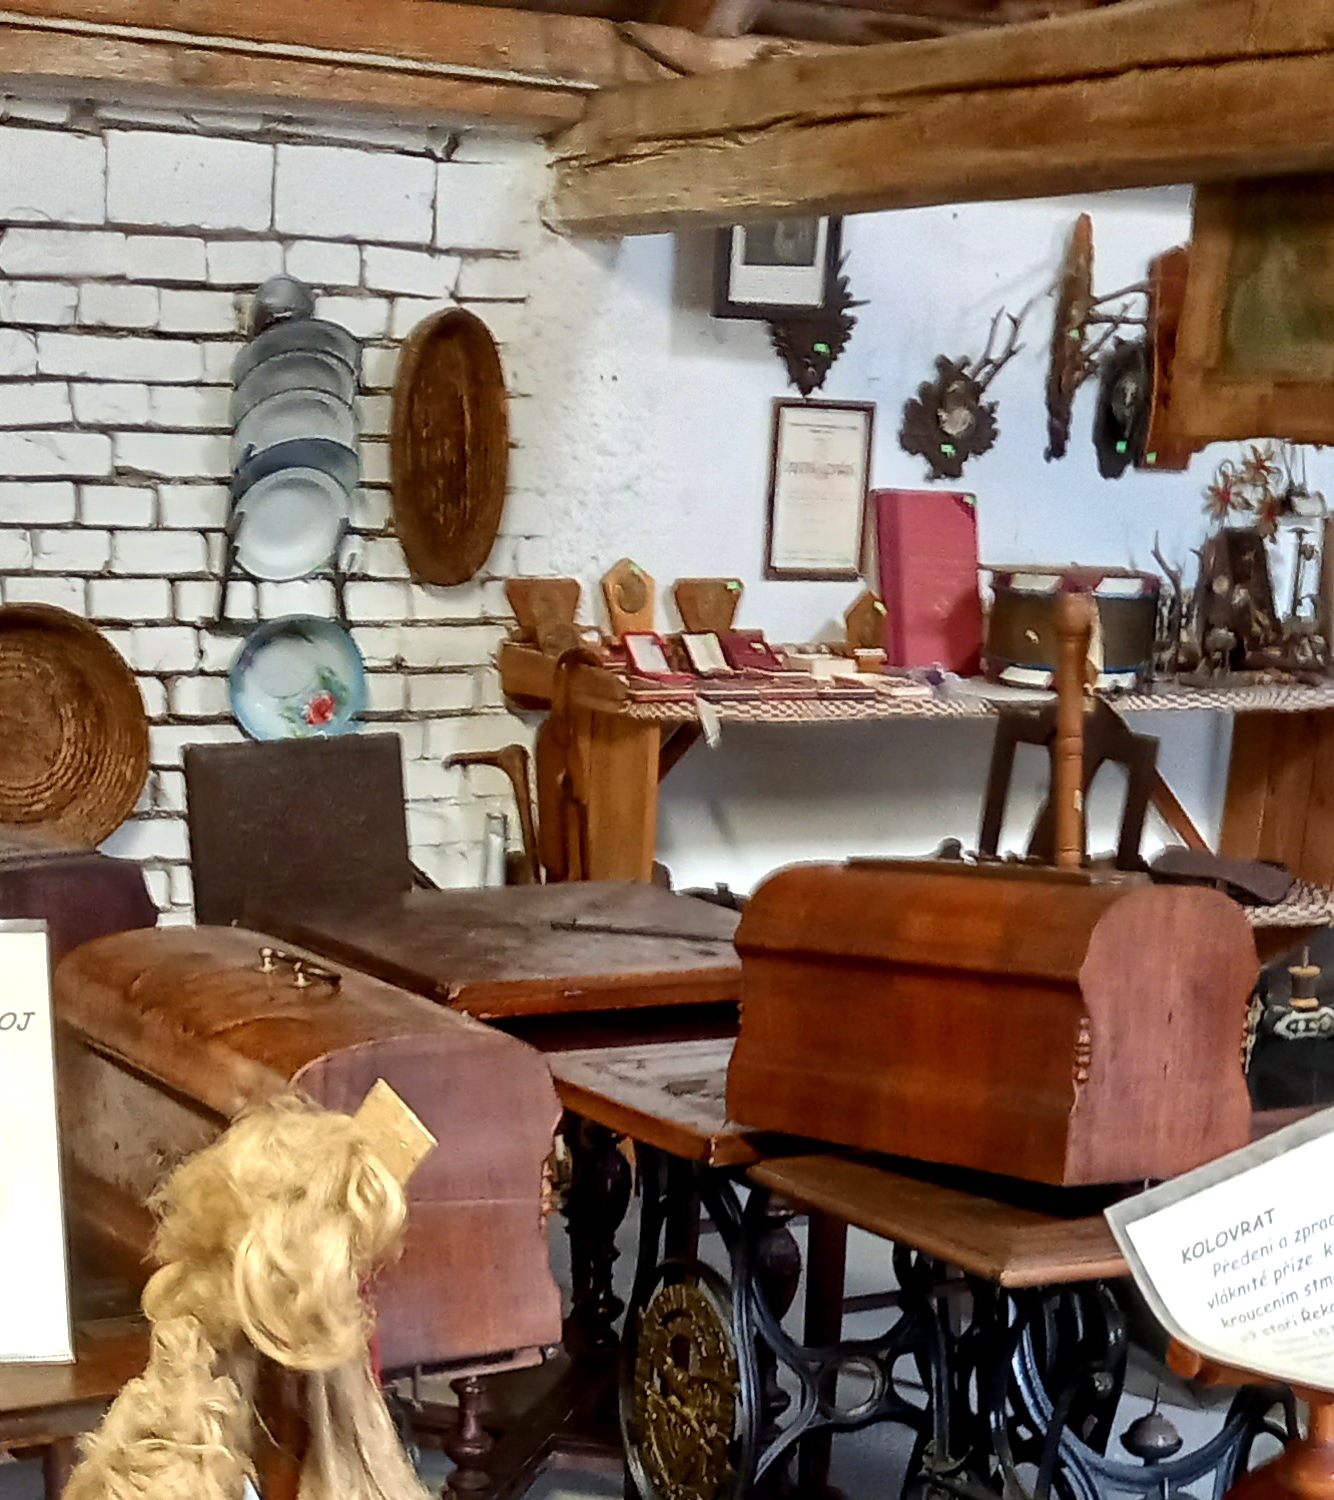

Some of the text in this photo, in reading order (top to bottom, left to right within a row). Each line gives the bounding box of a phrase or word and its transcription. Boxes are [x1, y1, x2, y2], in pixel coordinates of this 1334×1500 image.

[1181, 1207, 1276, 1264] KOLOVRAT
[1212, 1238, 1274, 1278] Předení
[1278, 1236, 1289, 1249] a
[1207, 1269, 1269, 1310] vláknité
[1220, 1290, 1300, 1330] kroucením
